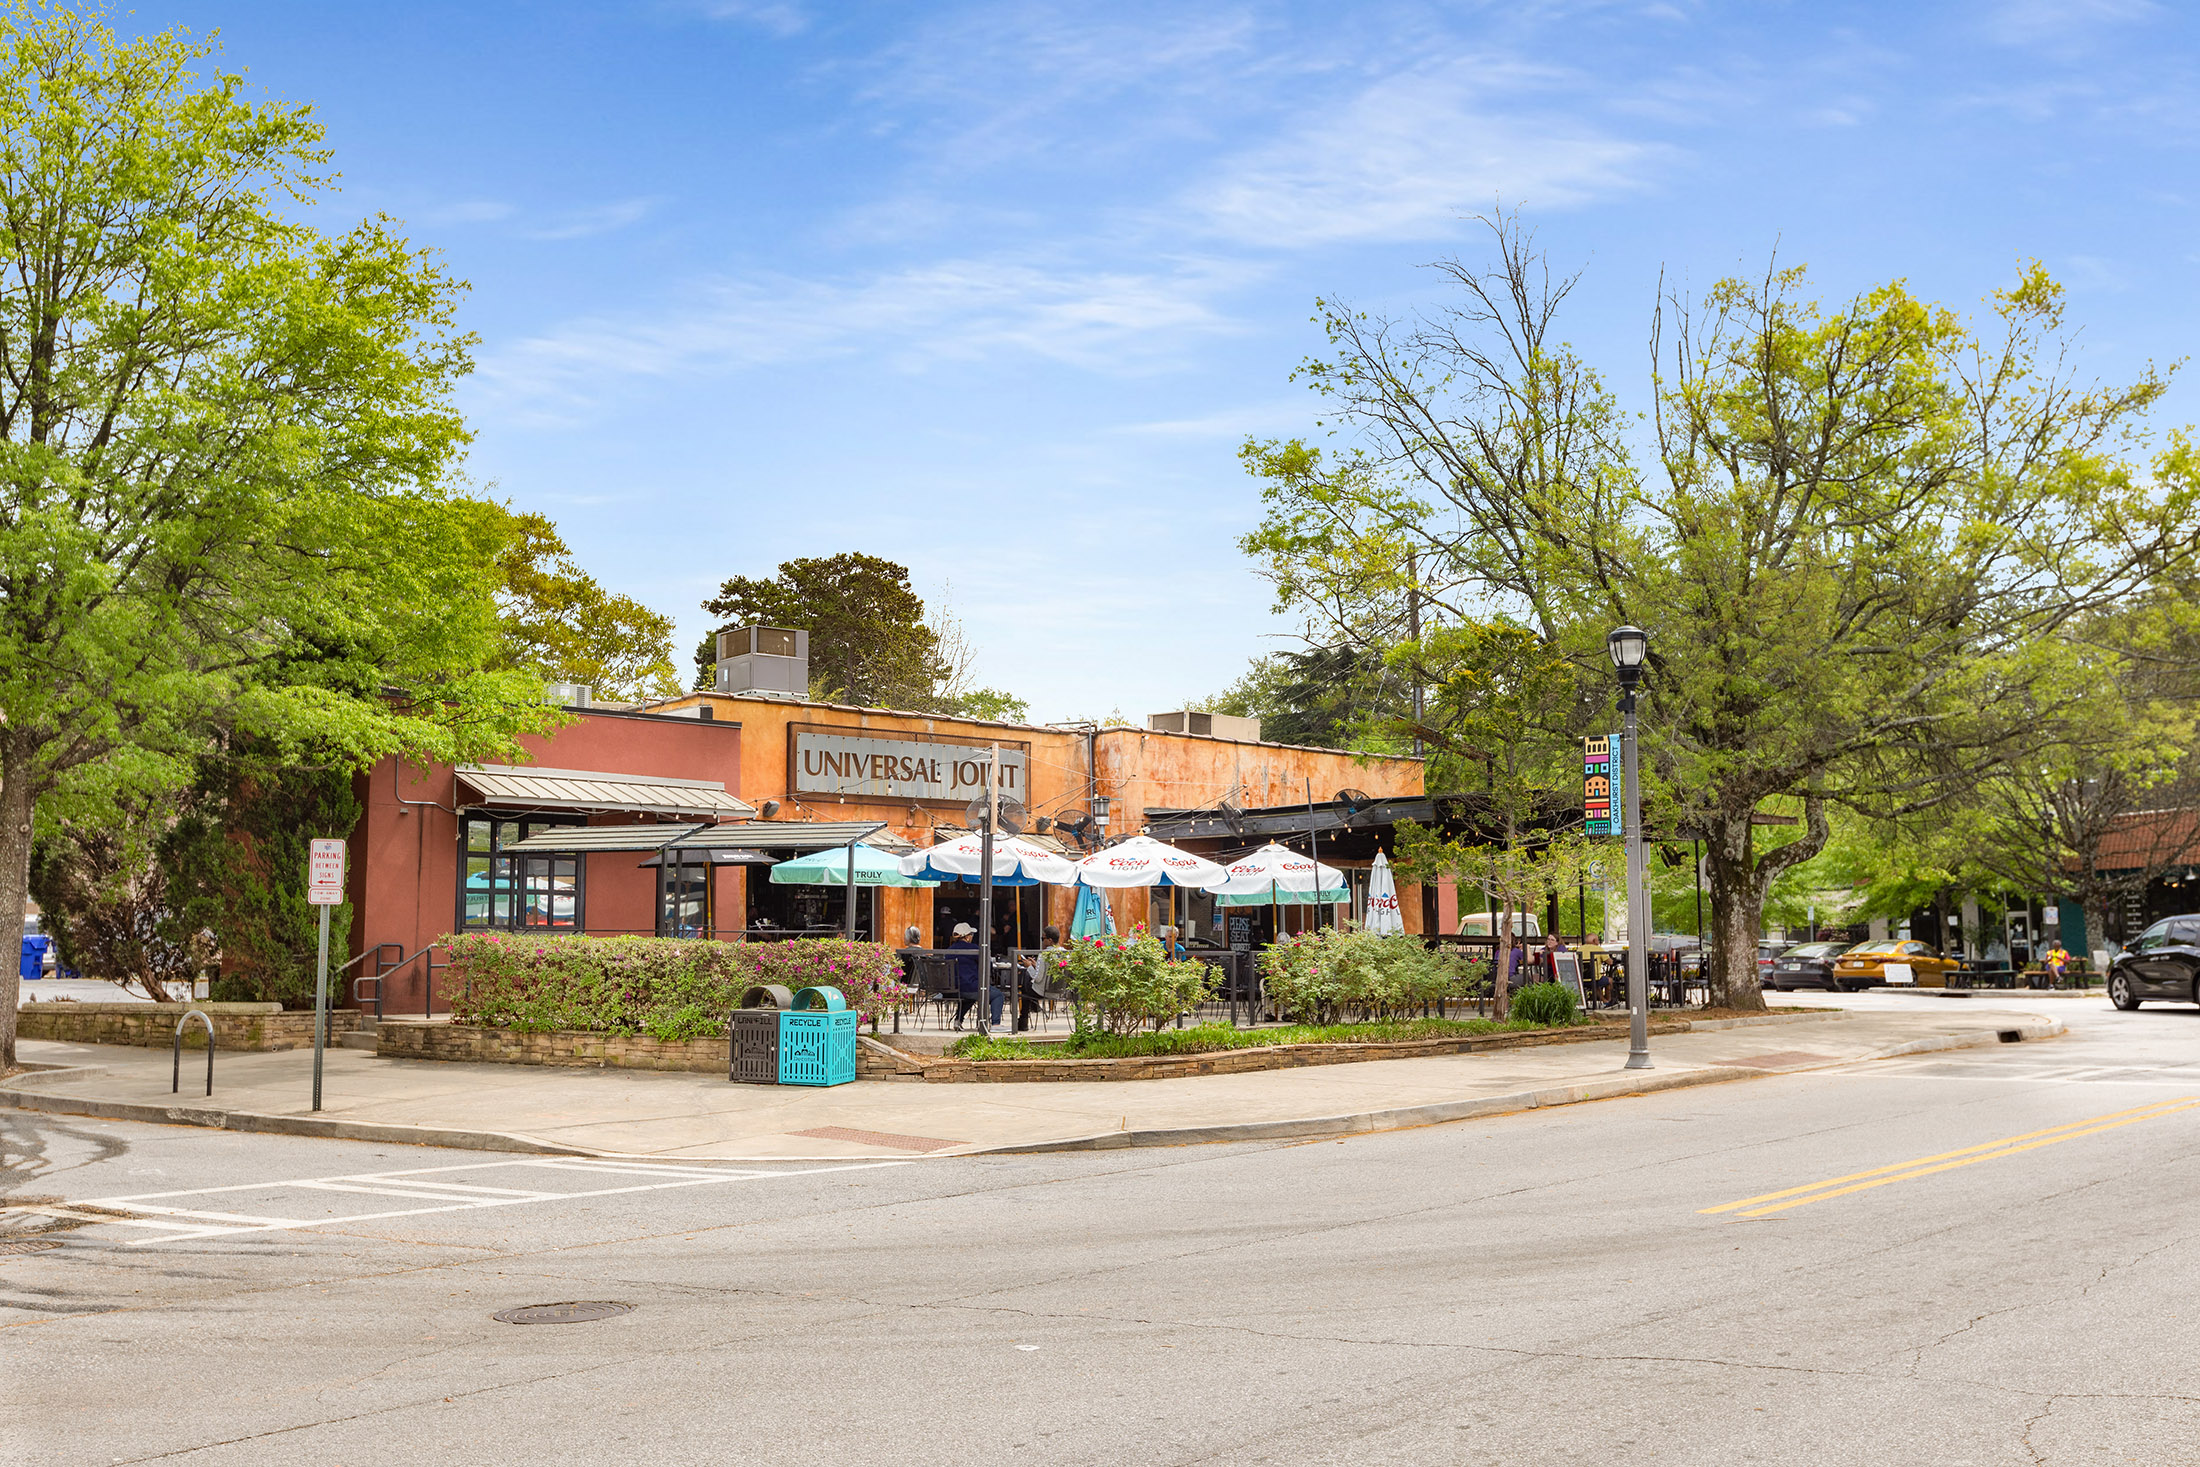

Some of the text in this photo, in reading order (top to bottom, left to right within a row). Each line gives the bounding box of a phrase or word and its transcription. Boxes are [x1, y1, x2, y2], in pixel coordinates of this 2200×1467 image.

[804, 749, 942, 783] UNIVERSAL
[1612, 782, 1620, 824] OAKHURST
[314, 852, 341, 860] PARKING
[1109, 857, 1150, 866] Coors
[1163, 858, 1197, 866] Coors
[1230, 931, 1250, 942] SEAT
[789, 1018, 821, 1027] RECYCLE
